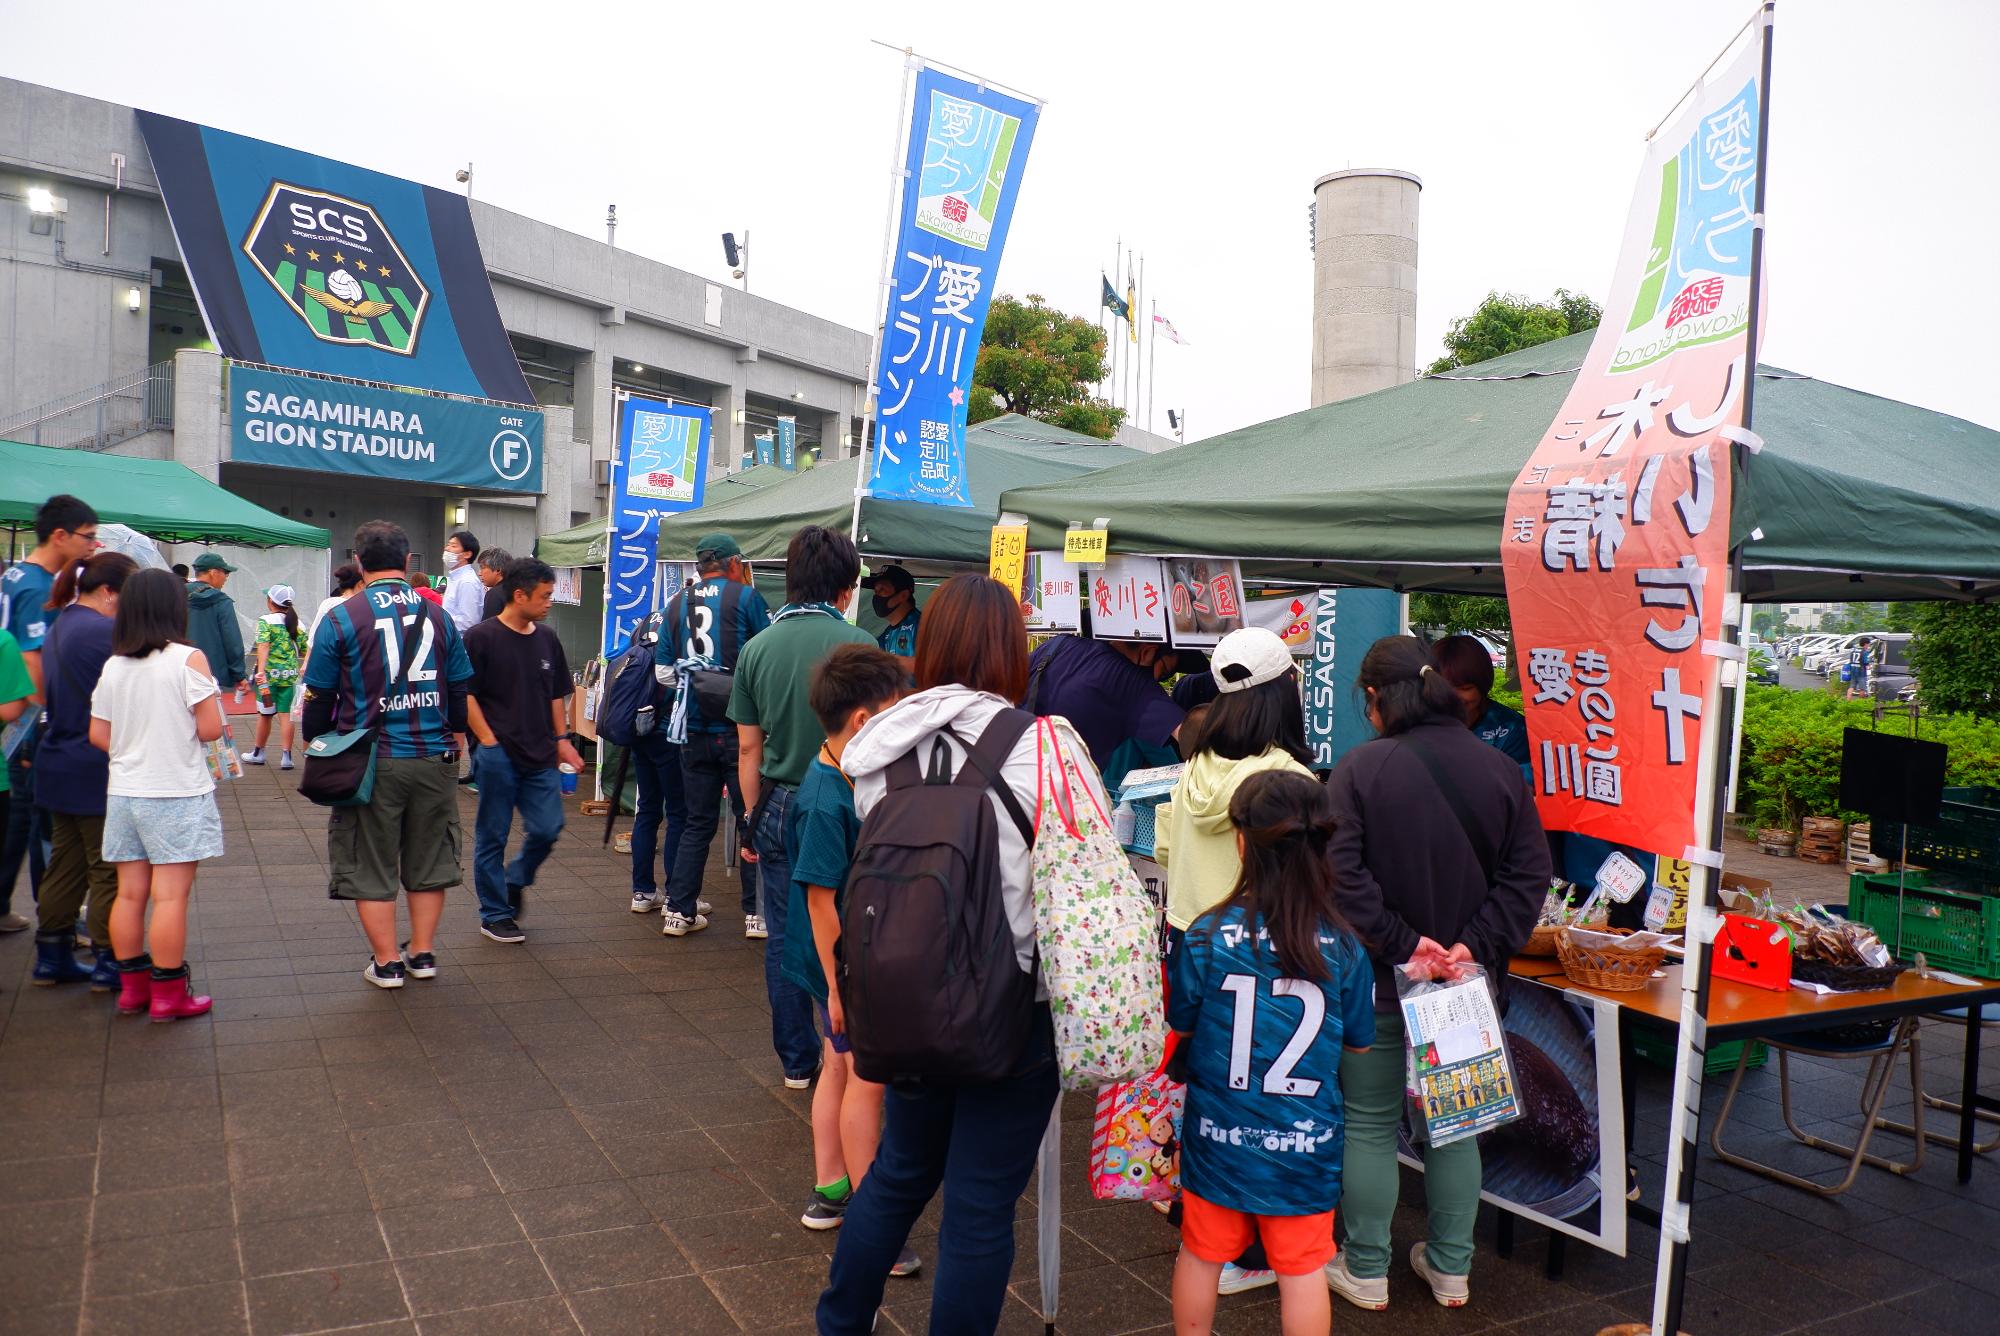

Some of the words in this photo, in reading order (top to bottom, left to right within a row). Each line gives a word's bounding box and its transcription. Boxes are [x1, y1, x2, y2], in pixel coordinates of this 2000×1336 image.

[290, 203, 368, 242] SCS
[291, 229, 318, 240] SPORTS
[920, 260, 981, 382] 愛川
[876, 251, 942, 478] ブランド
[245, 390, 424, 435] SAGAMIHARA
[500, 416, 523, 428] GATE
[245, 419, 316, 448] GION
[322, 429, 435, 463] STADIUM
[503, 441, 521, 469] F
[920, 420, 936, 479] 認定品
[935, 422, 950, 482] 愛川町
[613, 509, 659, 650] ブランド
[1044, 582, 1073, 597] 愛川町
[374, 614, 438, 684] 12
[1220, 973, 1326, 1097] 12
[1200, 1116, 1316, 1153] Futwork
